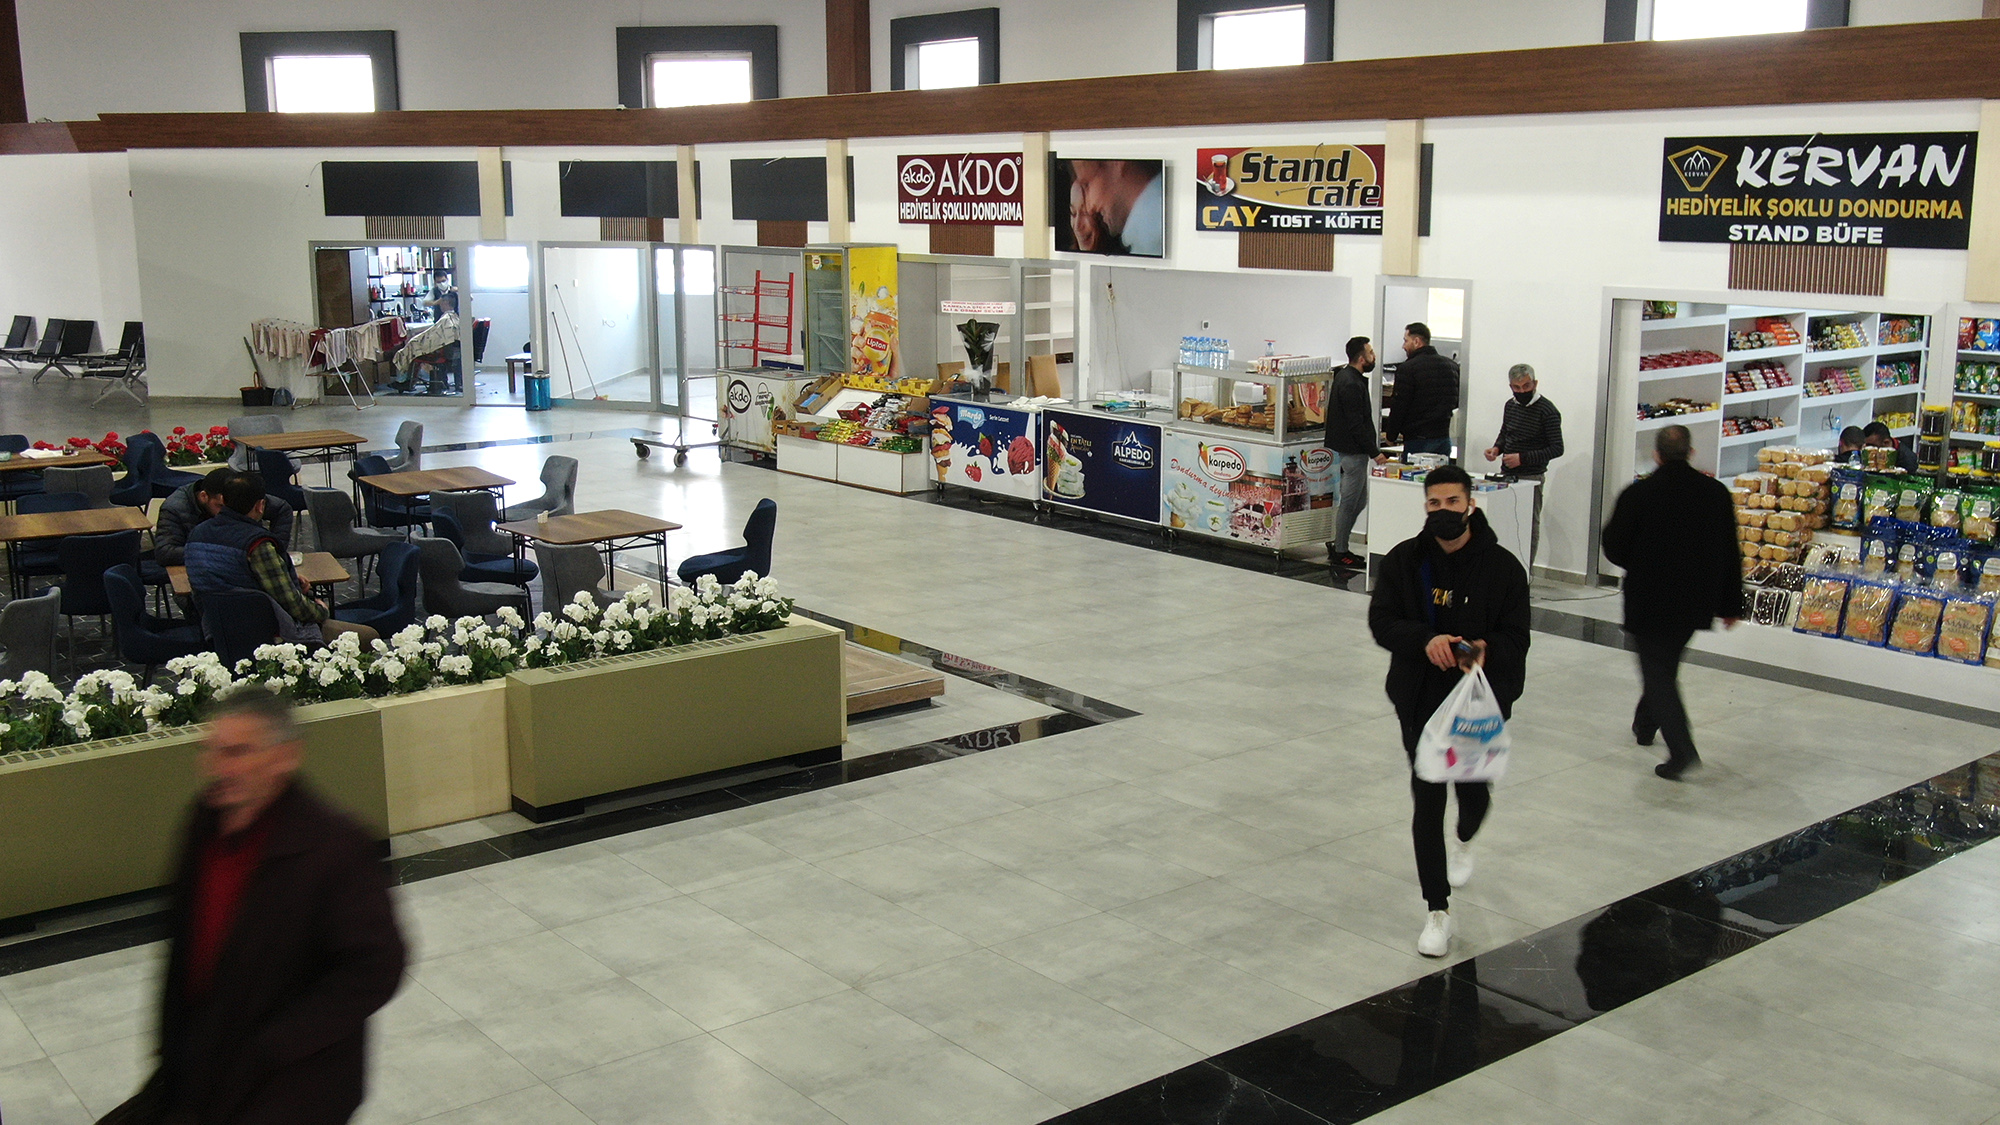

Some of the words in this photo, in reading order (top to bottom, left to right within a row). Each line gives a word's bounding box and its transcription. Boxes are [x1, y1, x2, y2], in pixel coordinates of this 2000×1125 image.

[903, 168, 932, 185] akdo
[1240, 149, 1351, 183] Stand
[1736, 144, 1966, 190] KERVAN
[1306, 178, 1381, 207] cafe
[900, 198, 941, 221] HEDİYELİK
[942, 201, 970, 223] ŞOKLU
[972, 201, 1023, 222] DONDURMA
[1666, 194, 1762, 216] HEDİYELİK
[1766, 198, 1833, 220] ŞOKLU
[1839, 199, 1963, 220] DONDURMA
[1270, 214, 1313, 228] TOST
[1325, 212, 1382, 229] KÖFTE
[1728, 224, 1809, 243] STAND
[1816, 222, 1883, 244] BÜFE
[867, 338, 886, 350] Lipton
[730, 387, 749, 403] akdo
[1114, 445, 1151, 461] ALPEDO
[1209, 455, 1241, 471] karpedo
[1170, 458, 1208, 488] Dondurma
